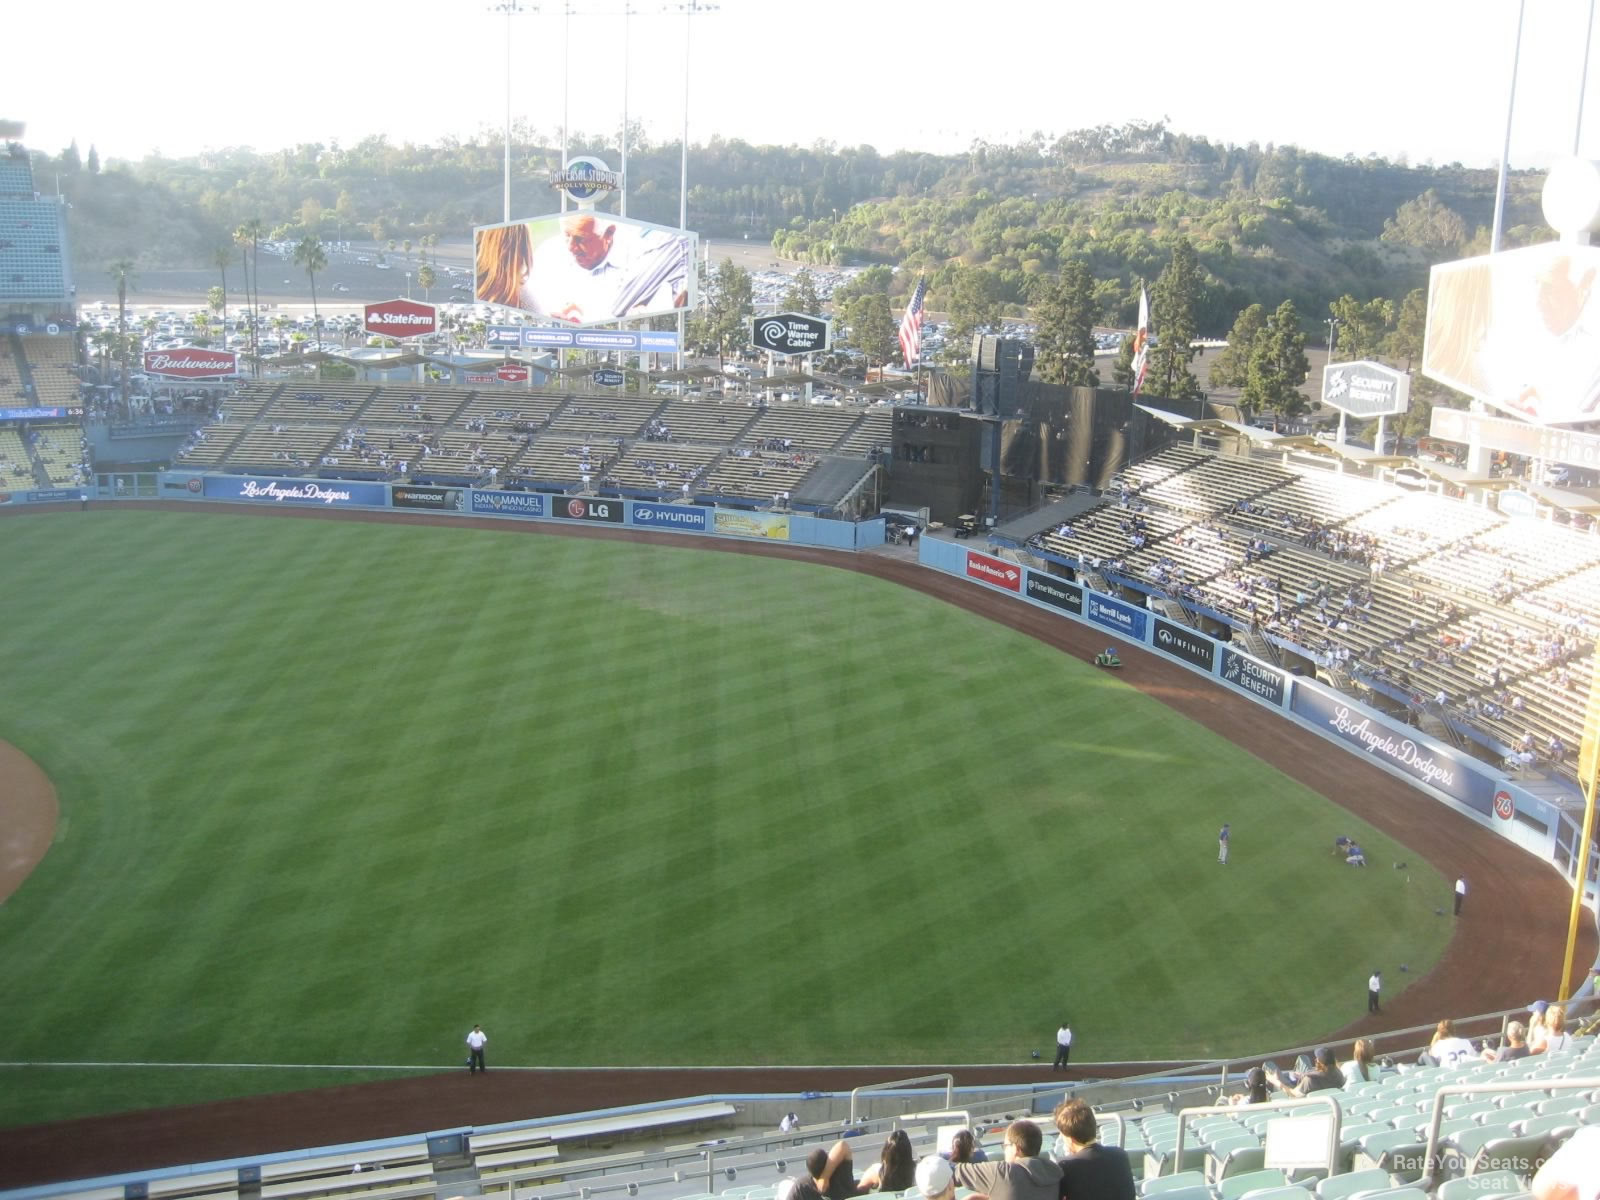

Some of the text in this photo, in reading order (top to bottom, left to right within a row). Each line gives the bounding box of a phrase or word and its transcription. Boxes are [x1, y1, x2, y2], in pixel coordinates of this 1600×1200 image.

[549, 169, 617, 185] UNIVERSAL STUDIOS
[788, 321, 810, 331] Time
[787, 330, 820, 340] Warner
[787, 339, 812, 348] Cable
[148, 354, 233, 370] Budweiser
[67, 407, 84, 415] 6:36
[240, 480, 350, 504] Los Angeles Dodgers
[474, 493, 541, 507] SAN MANUEL
[588, 503, 609, 518] LG
[656, 511, 705, 524] HYUNDAI
[969, 560, 980, 570] Bank
[985, 565, 1005, 579] America
[1035, 580, 1081, 605] Time Warner Cable
[1099, 604, 1116, 618] Merrill
[1116, 610, 1132, 625] Lynch
[1173, 637, 1210, 659] INFINITI
[1241, 658, 1281, 687] SECURITY
[1240, 672, 1275, 699] BENEFIT
[1329, 706, 1455, 787] Los Angeles Dodgers
[1496, 796, 1512, 815] 76
